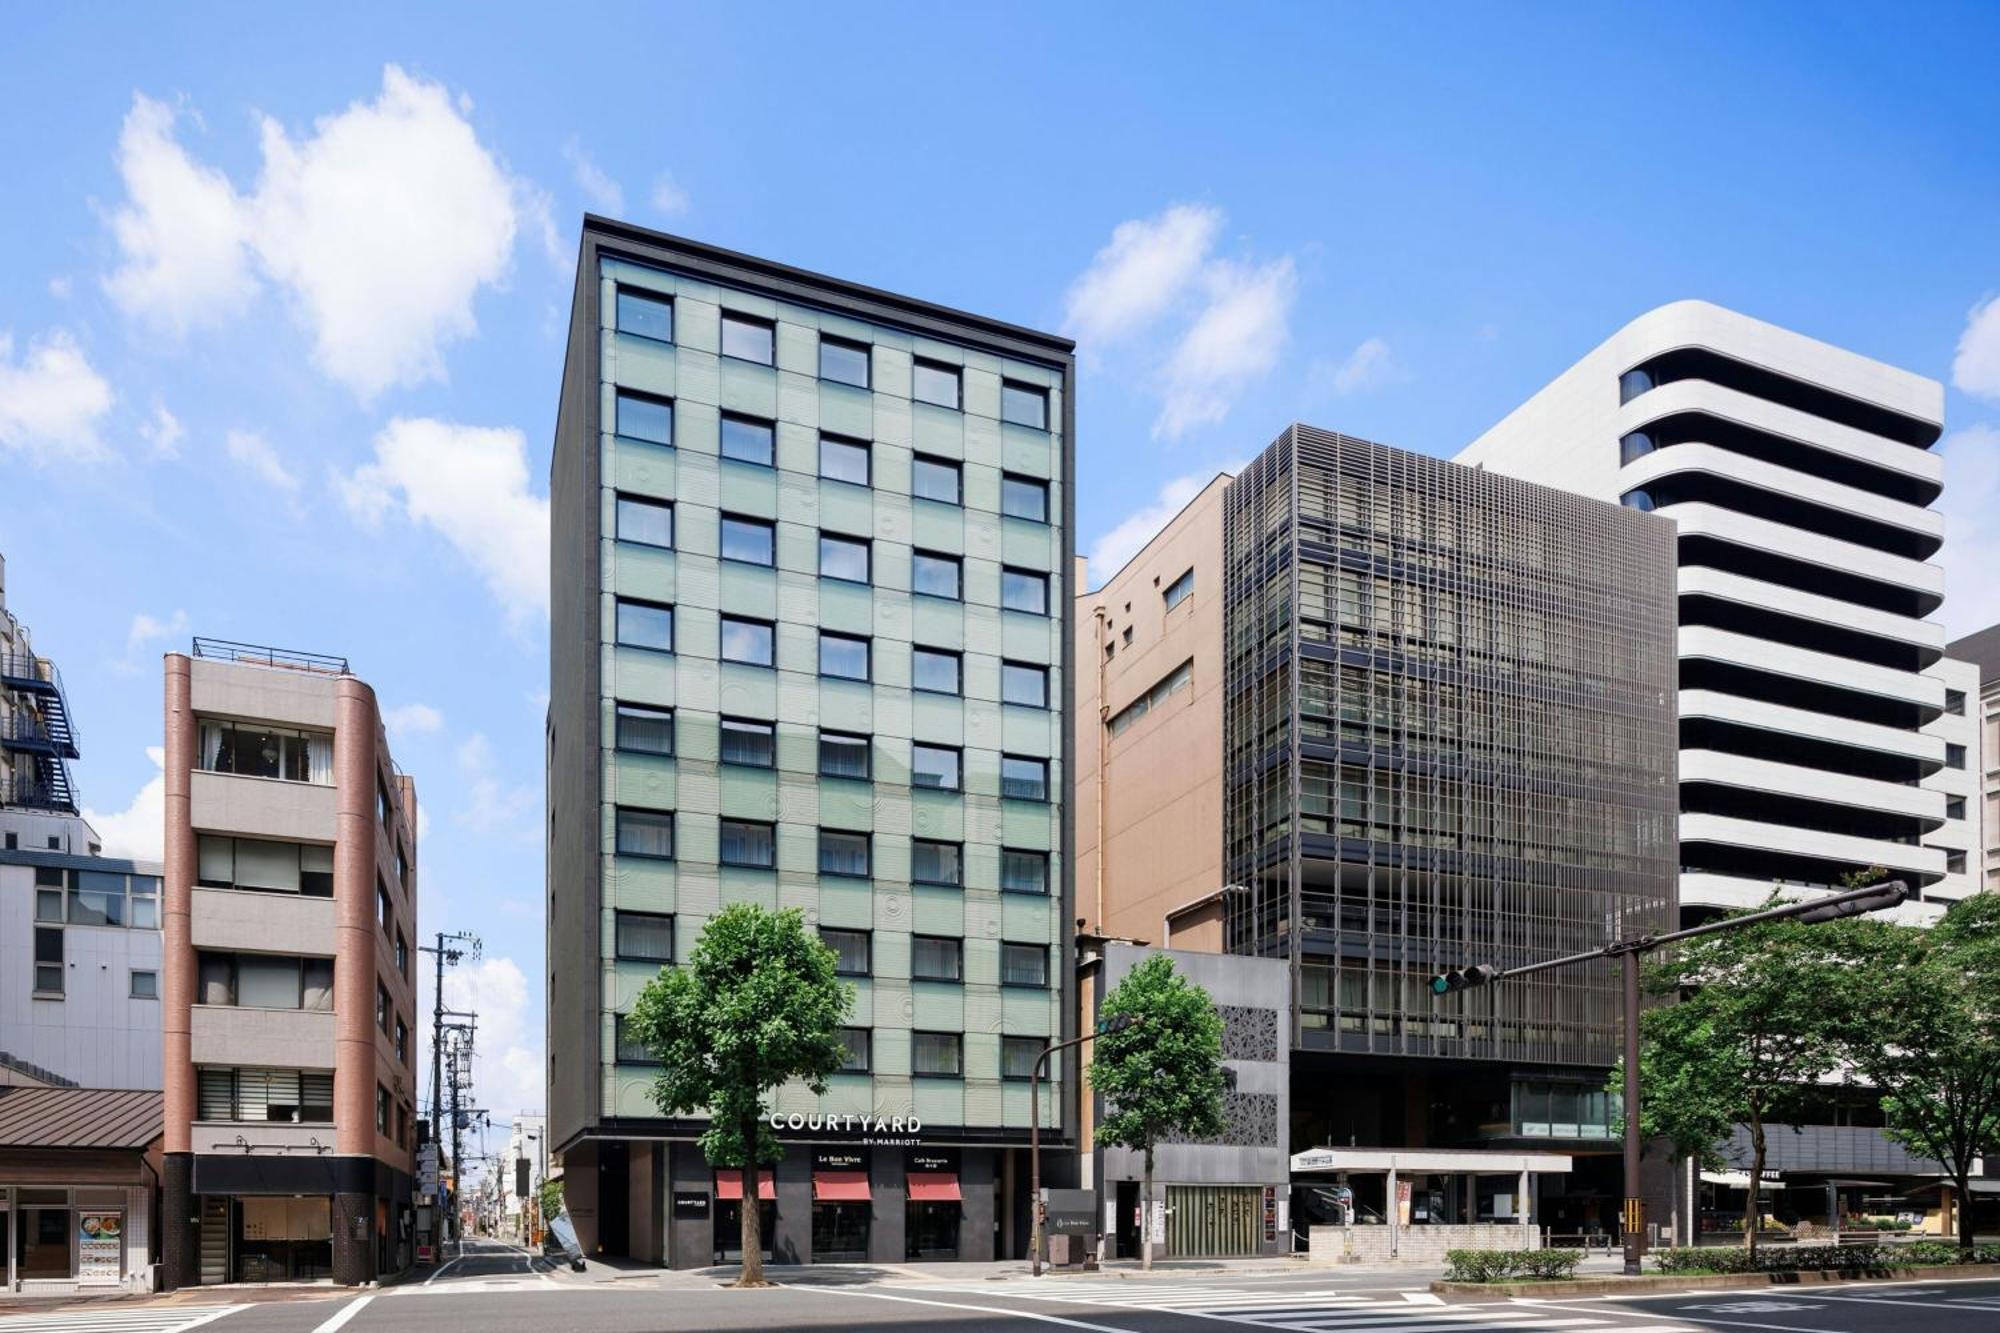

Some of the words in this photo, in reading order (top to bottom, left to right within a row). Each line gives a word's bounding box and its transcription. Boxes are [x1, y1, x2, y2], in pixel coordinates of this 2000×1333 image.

[770, 1112, 921, 1133] COURTYARD
[863, 1137, 874, 1146] BY
[876, 1138, 921, 1147] MARRIOTT
